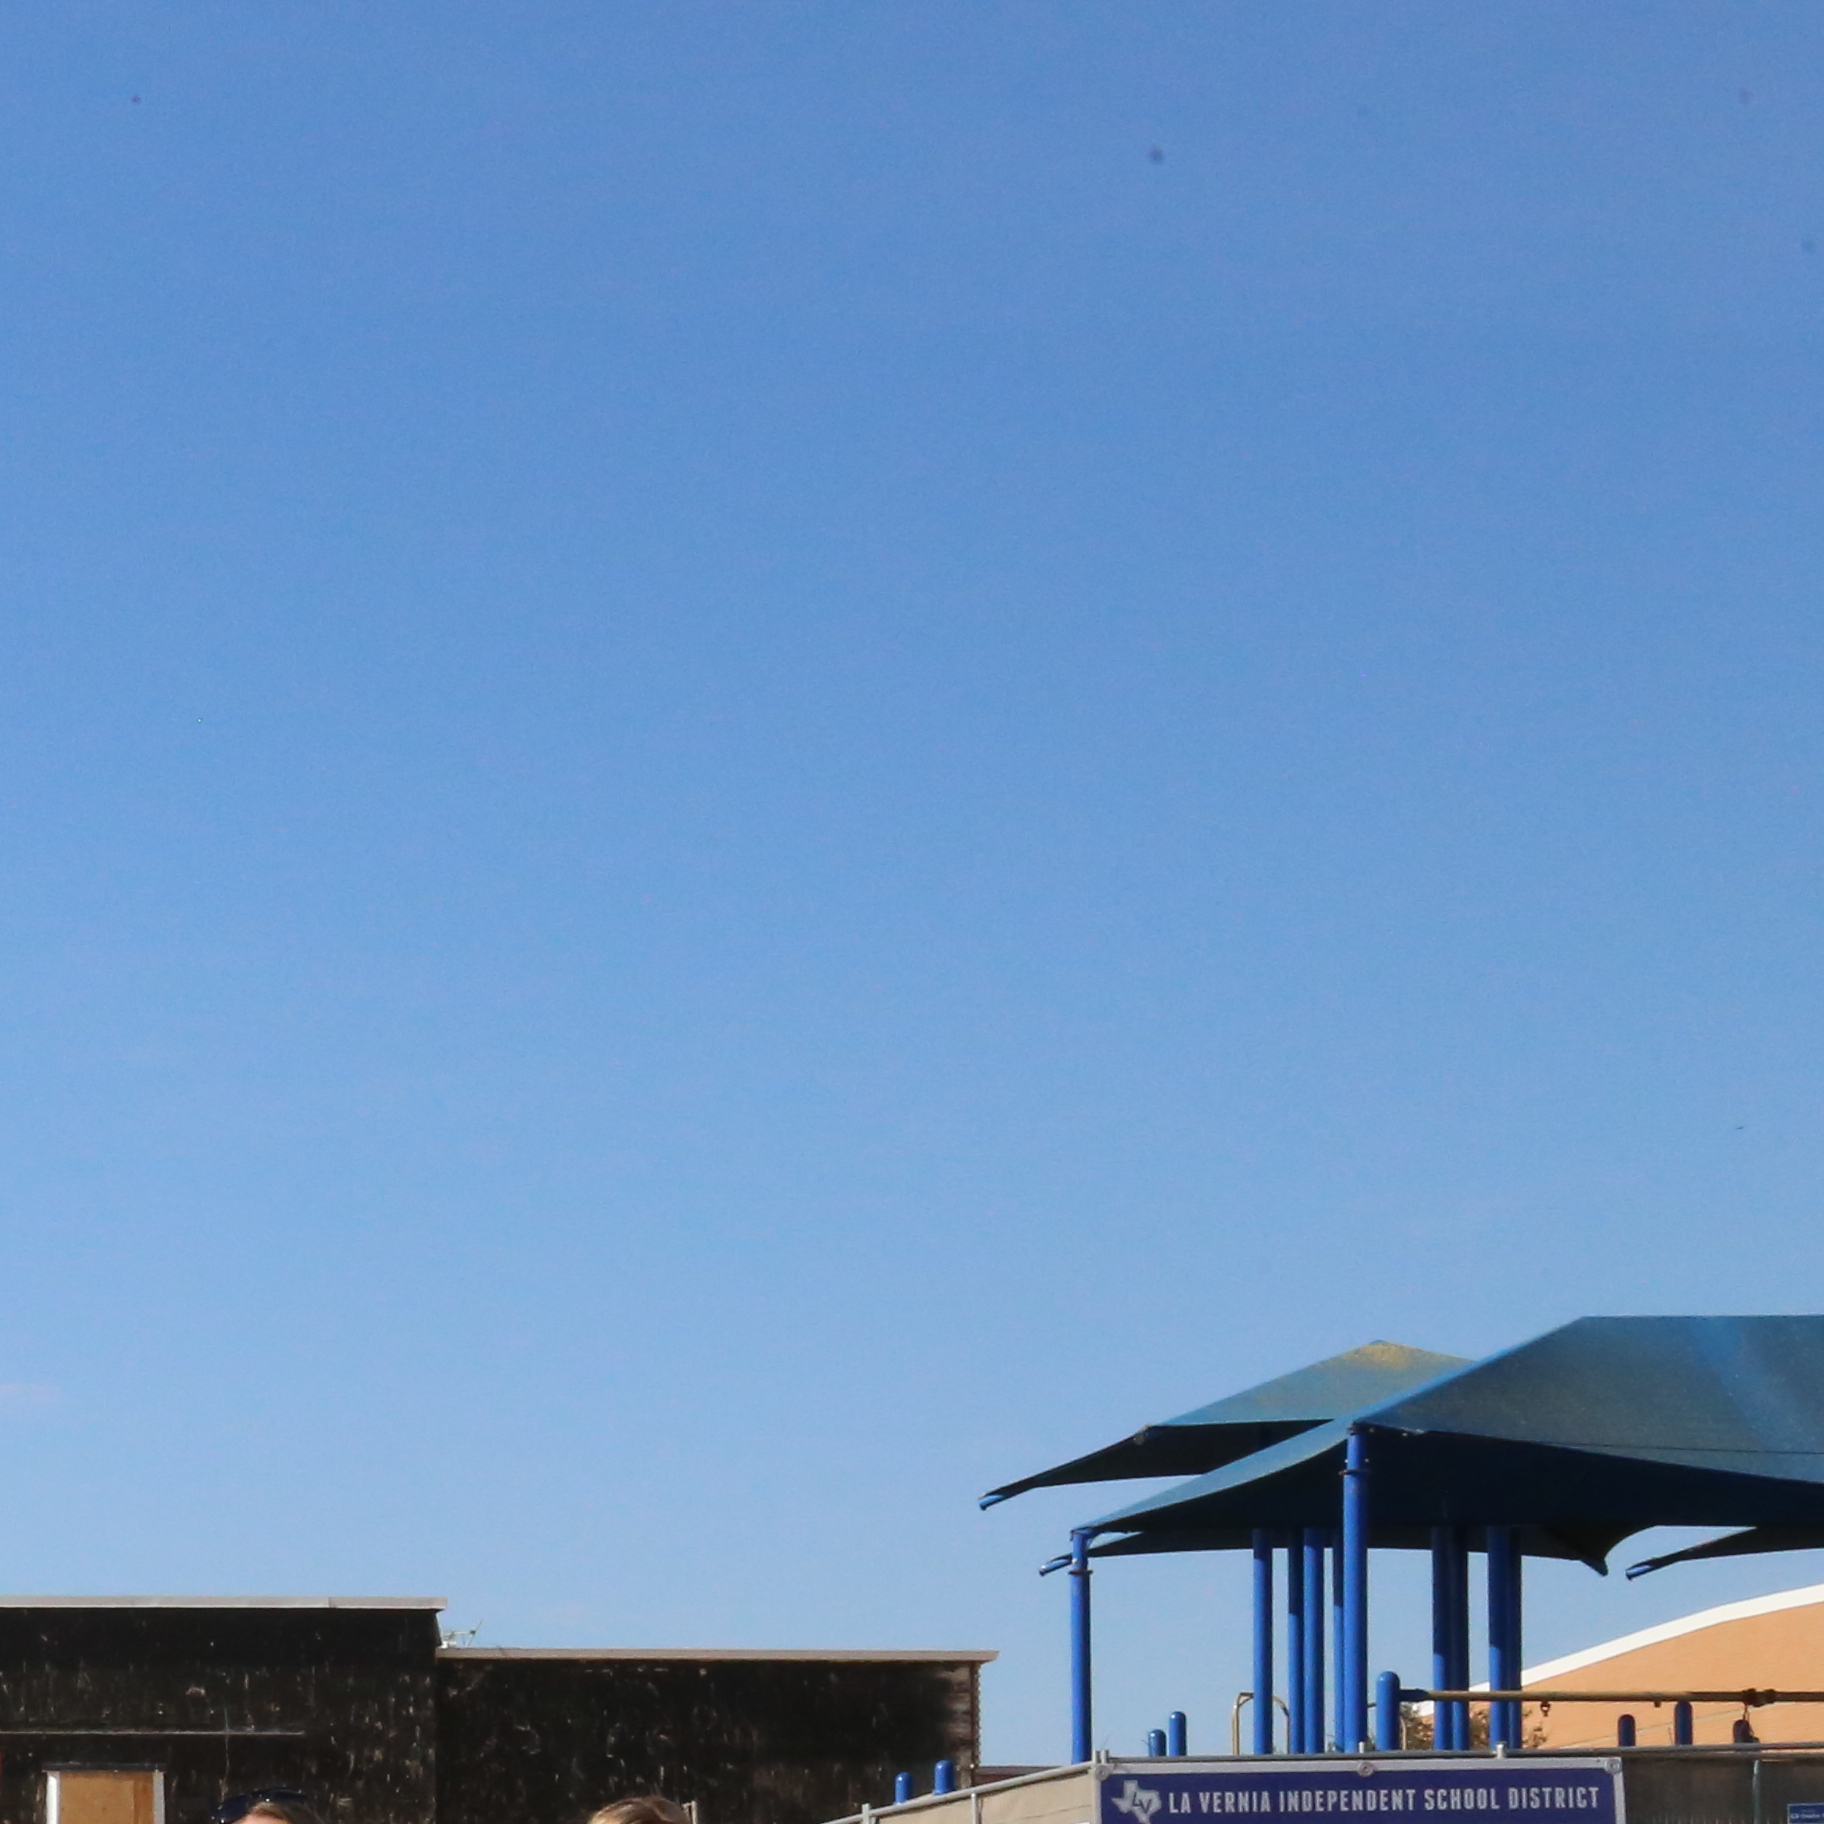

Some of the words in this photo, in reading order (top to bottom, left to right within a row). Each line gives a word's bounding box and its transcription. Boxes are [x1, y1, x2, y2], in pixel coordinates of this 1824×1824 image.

[1132, 1792, 1153, 1813] LV
[1169, 1792, 1191, 1814] LA
[1199, 1791, 1271, 1813] VERNIA
[1279, 1789, 1416, 1812] INDEPENDENT
[1424, 1788, 1500, 1811] SCHOOL
[1508, 1787, 1599, 1809] DISTRICT
